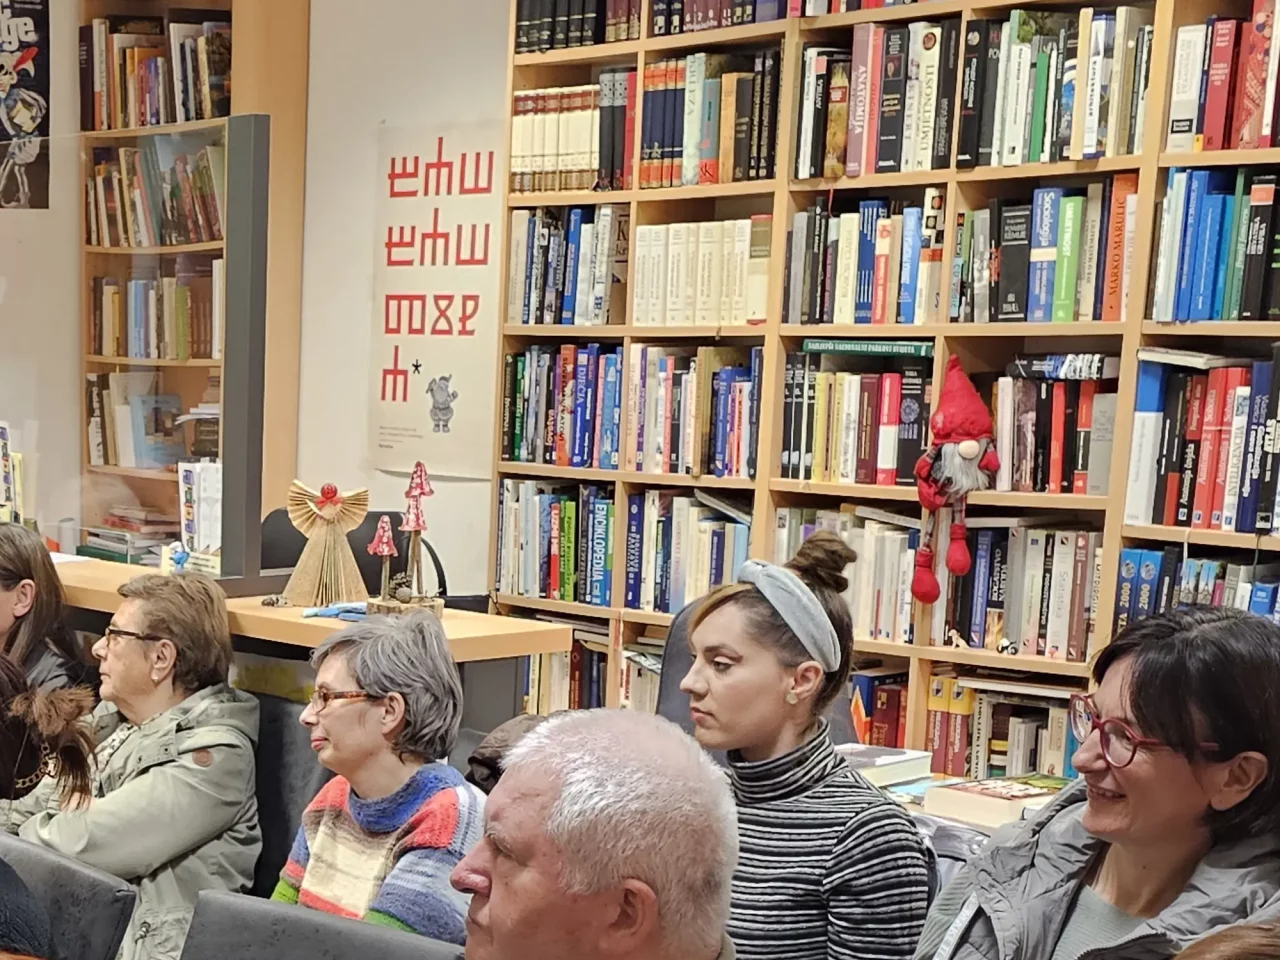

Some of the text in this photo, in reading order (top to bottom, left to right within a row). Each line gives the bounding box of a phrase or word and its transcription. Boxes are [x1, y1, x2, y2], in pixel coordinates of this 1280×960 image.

[854, 65, 866, 135] ANATOMIJA
[919, 64, 935, 152] UMJETNOSTI
[1087, 60, 1098, 117] arhitektura
[1038, 192, 1055, 246] Sociologija
[1062, 203, 1075, 256] UMJETNOST
[1250, 217, 1261, 254] HRVATSKA
[1257, 223, 1267, 254] GRAFIKA
[1108, 254, 1122, 296] MARKO
[1204, 389, 1216, 422] Sobotta
[1216, 440, 1230, 485] Anatomija
[1224, 389, 1234, 422] Sobotta
[1227, 426, 1245, 497] INTELIGENCIJA
[1263, 419, 1275, 453] ATLAS
[1198, 441, 1212, 484] Anatomija
[593, 504, 607, 581] ENCIKLOPEDIJA
[992, 549, 1001, 601] BOGATSTVO
[1056, 571, 1068, 619] Statistika
[1091, 563, 1101, 615] MITOLOGIJA
[1120, 582, 1131, 608] 2000
[1139, 584, 1150, 610] 2000
